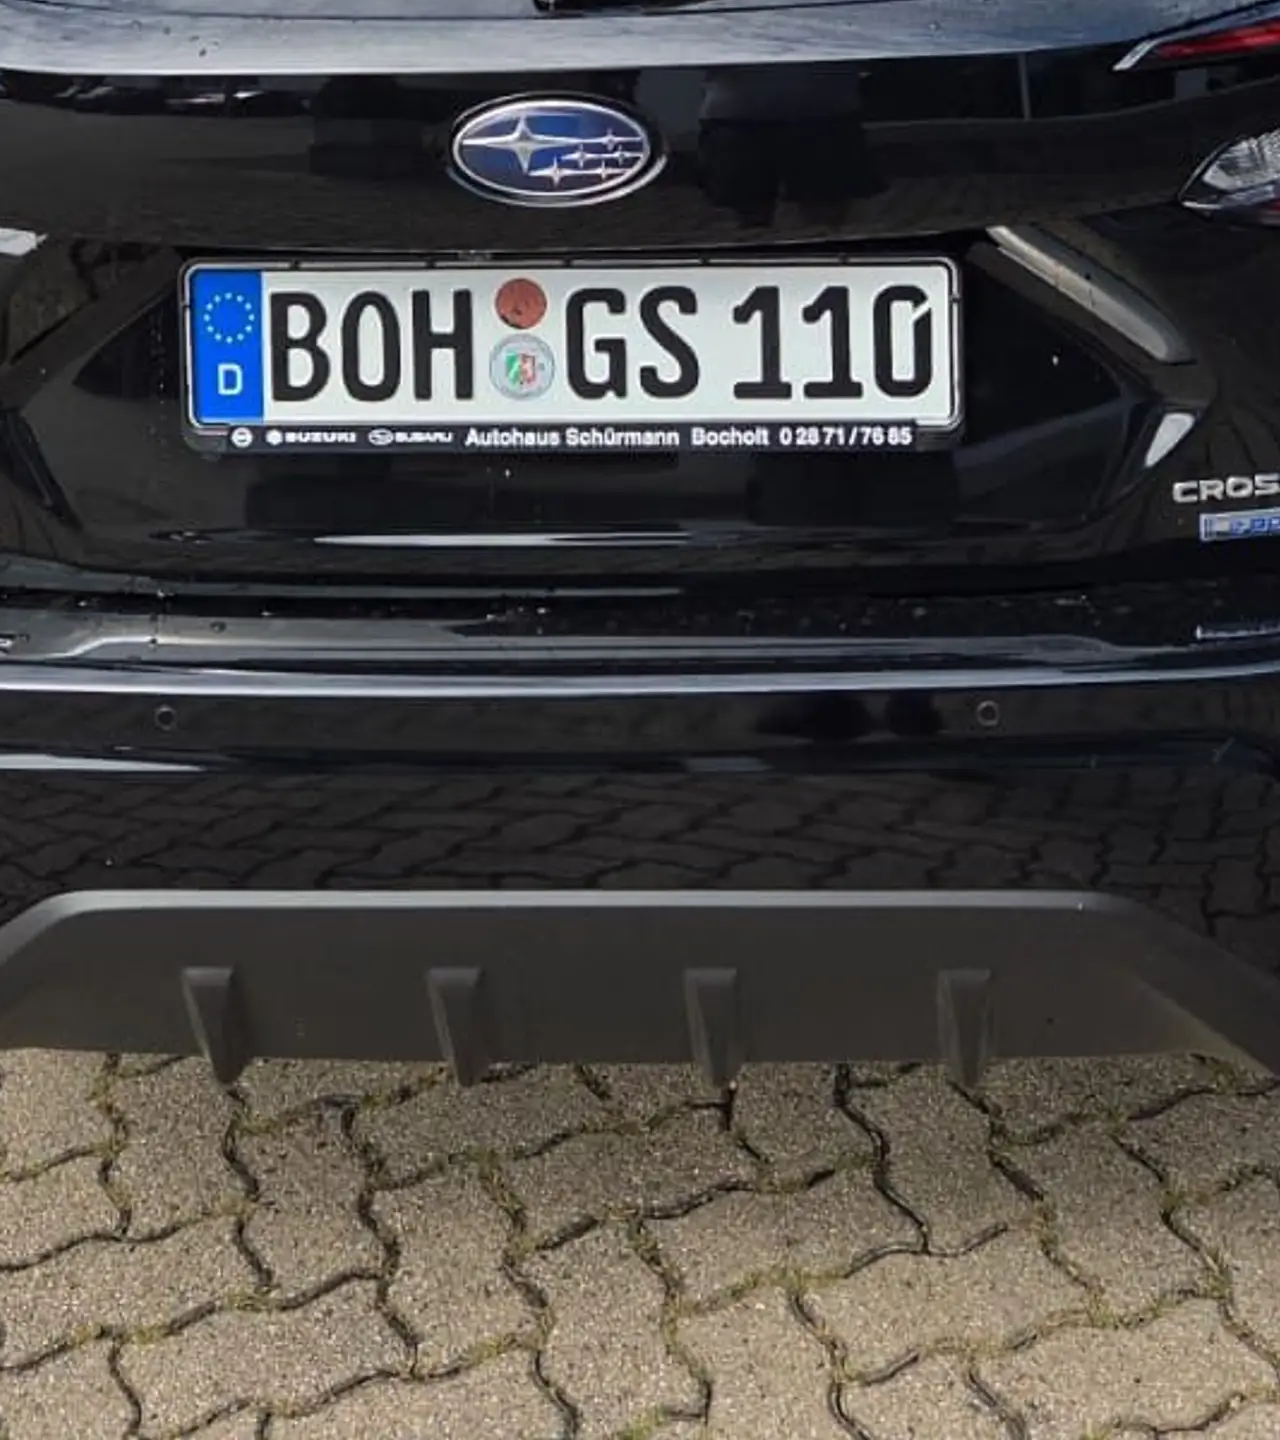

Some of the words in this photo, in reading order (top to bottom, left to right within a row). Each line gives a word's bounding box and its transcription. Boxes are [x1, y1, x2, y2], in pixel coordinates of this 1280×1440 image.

[218, 363, 243, 395] D
[269, 288, 474, 402] BOH
[566, 286, 700, 400] GS
[732, 284, 933, 399] 110
[284, 431, 357, 444] SUZUKI
[464, 427, 560, 447] Autohaus
[565, 426, 680, 446] Schürmann
[691, 426, 770, 446] Bocholt
